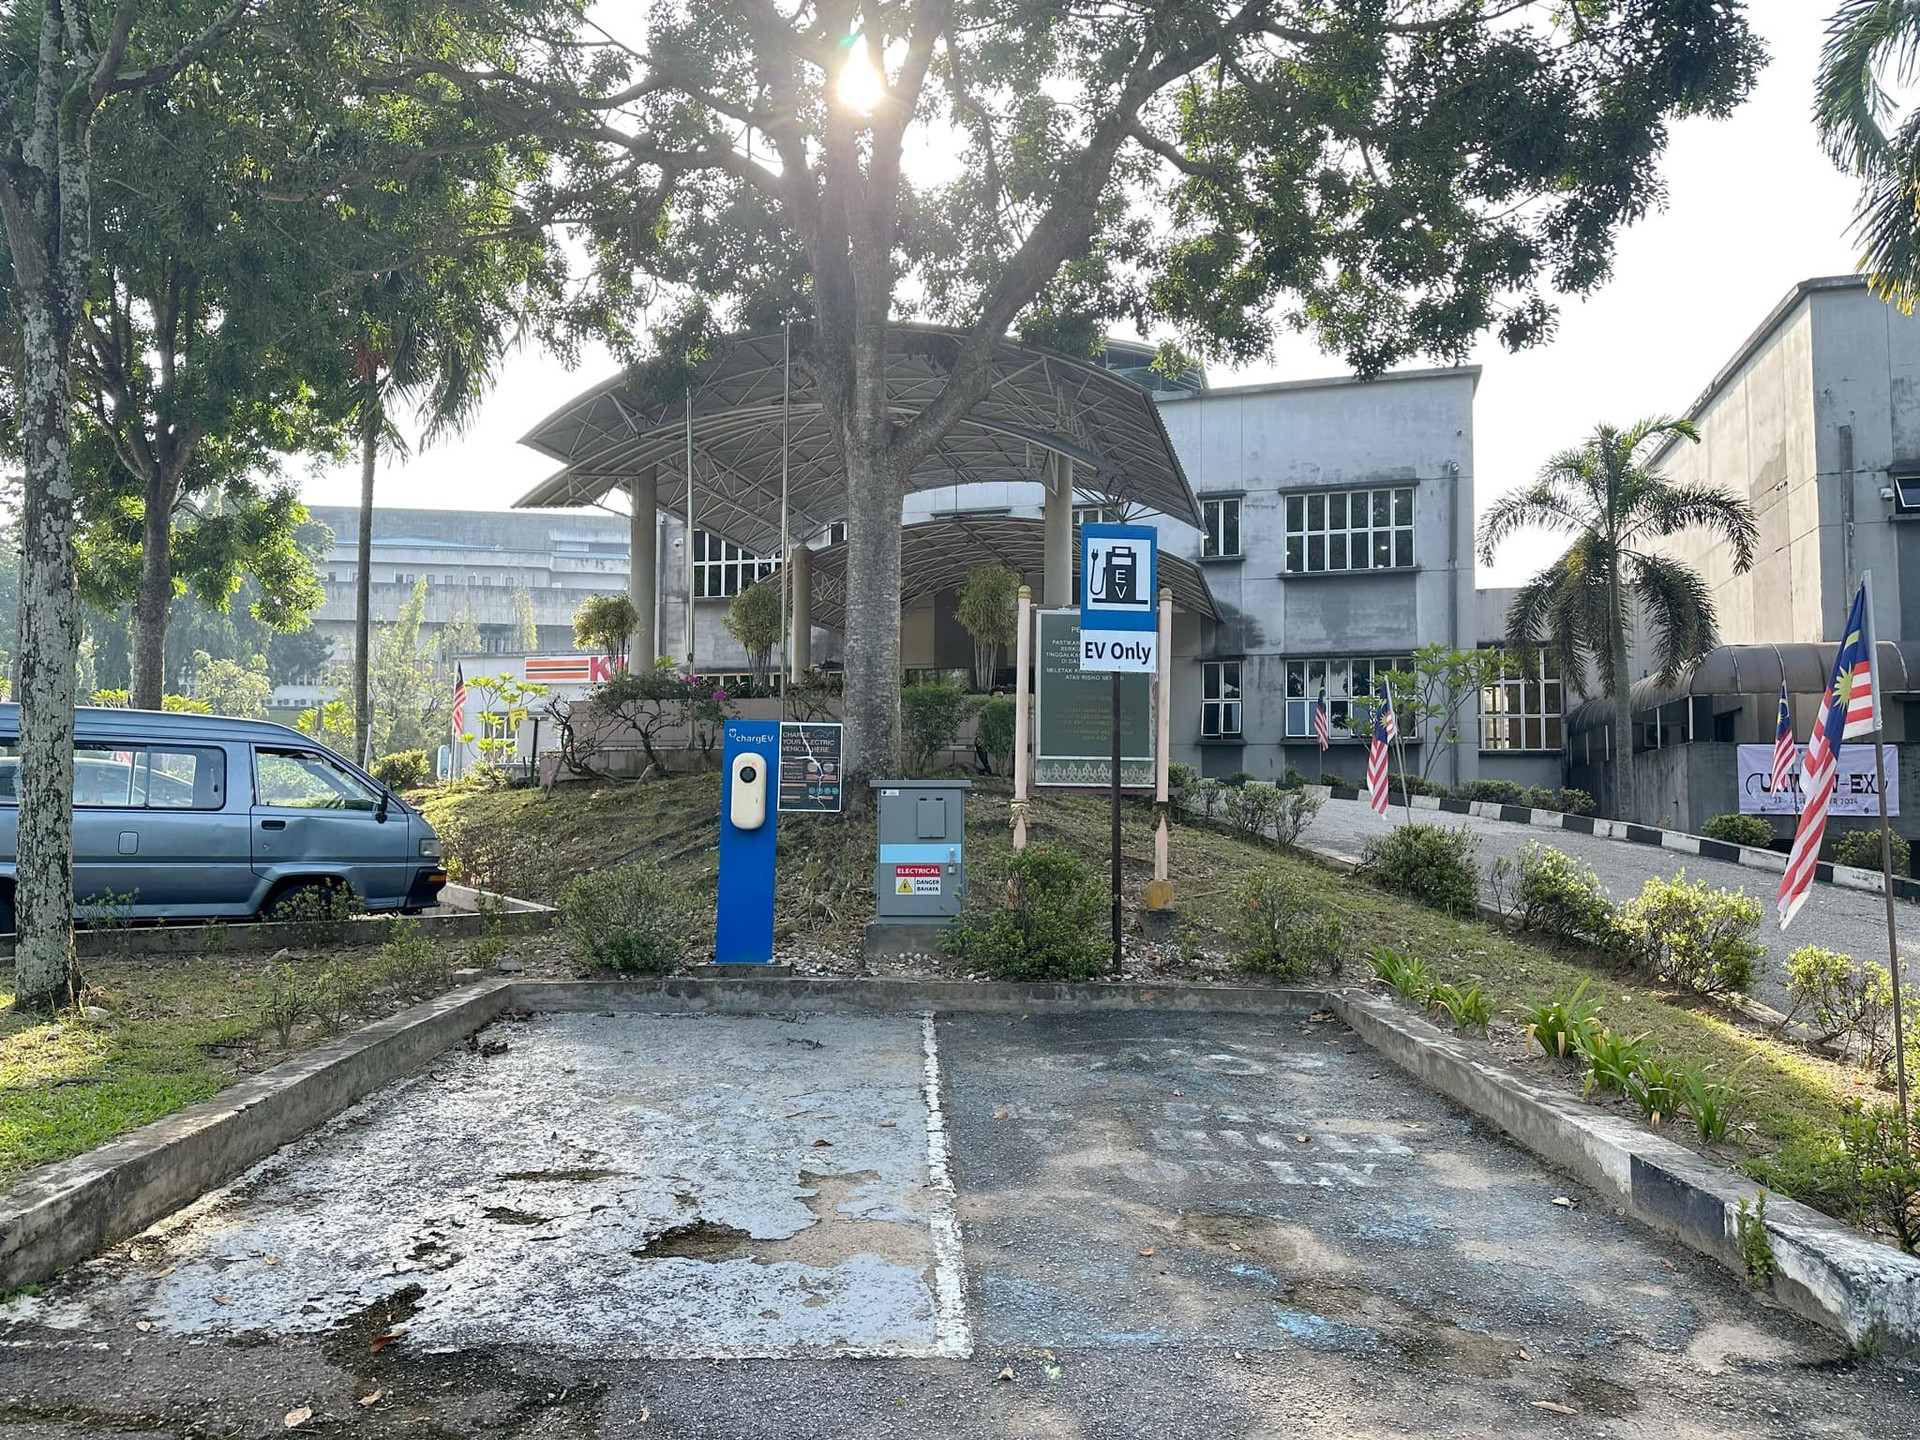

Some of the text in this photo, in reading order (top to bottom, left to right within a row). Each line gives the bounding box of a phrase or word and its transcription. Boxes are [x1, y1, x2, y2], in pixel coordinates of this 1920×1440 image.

[1085, 641, 1152, 665] EV Only
[735, 734, 774, 744] chargEV
[897, 867, 940, 875] ELECTRICAL
